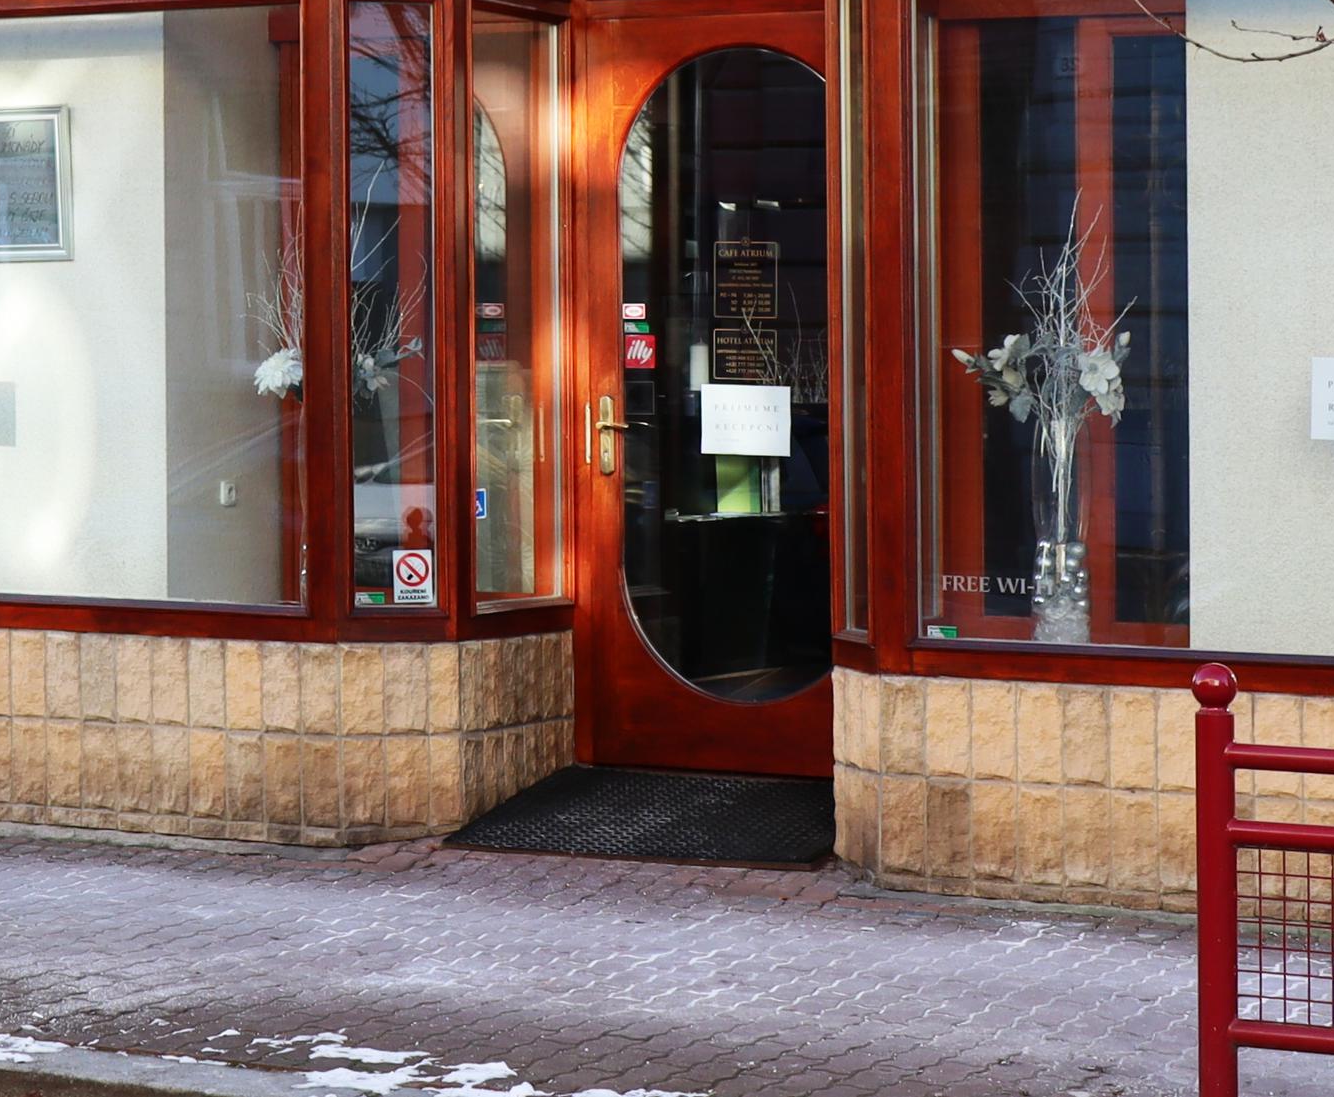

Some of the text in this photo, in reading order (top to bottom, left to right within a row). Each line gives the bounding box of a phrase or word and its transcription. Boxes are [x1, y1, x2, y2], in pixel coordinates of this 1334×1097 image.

[717, 337, 742, 345] HOTEL
[627, 339, 653, 365] illy
[942, 575, 1053, 595] FREE WI-FI
